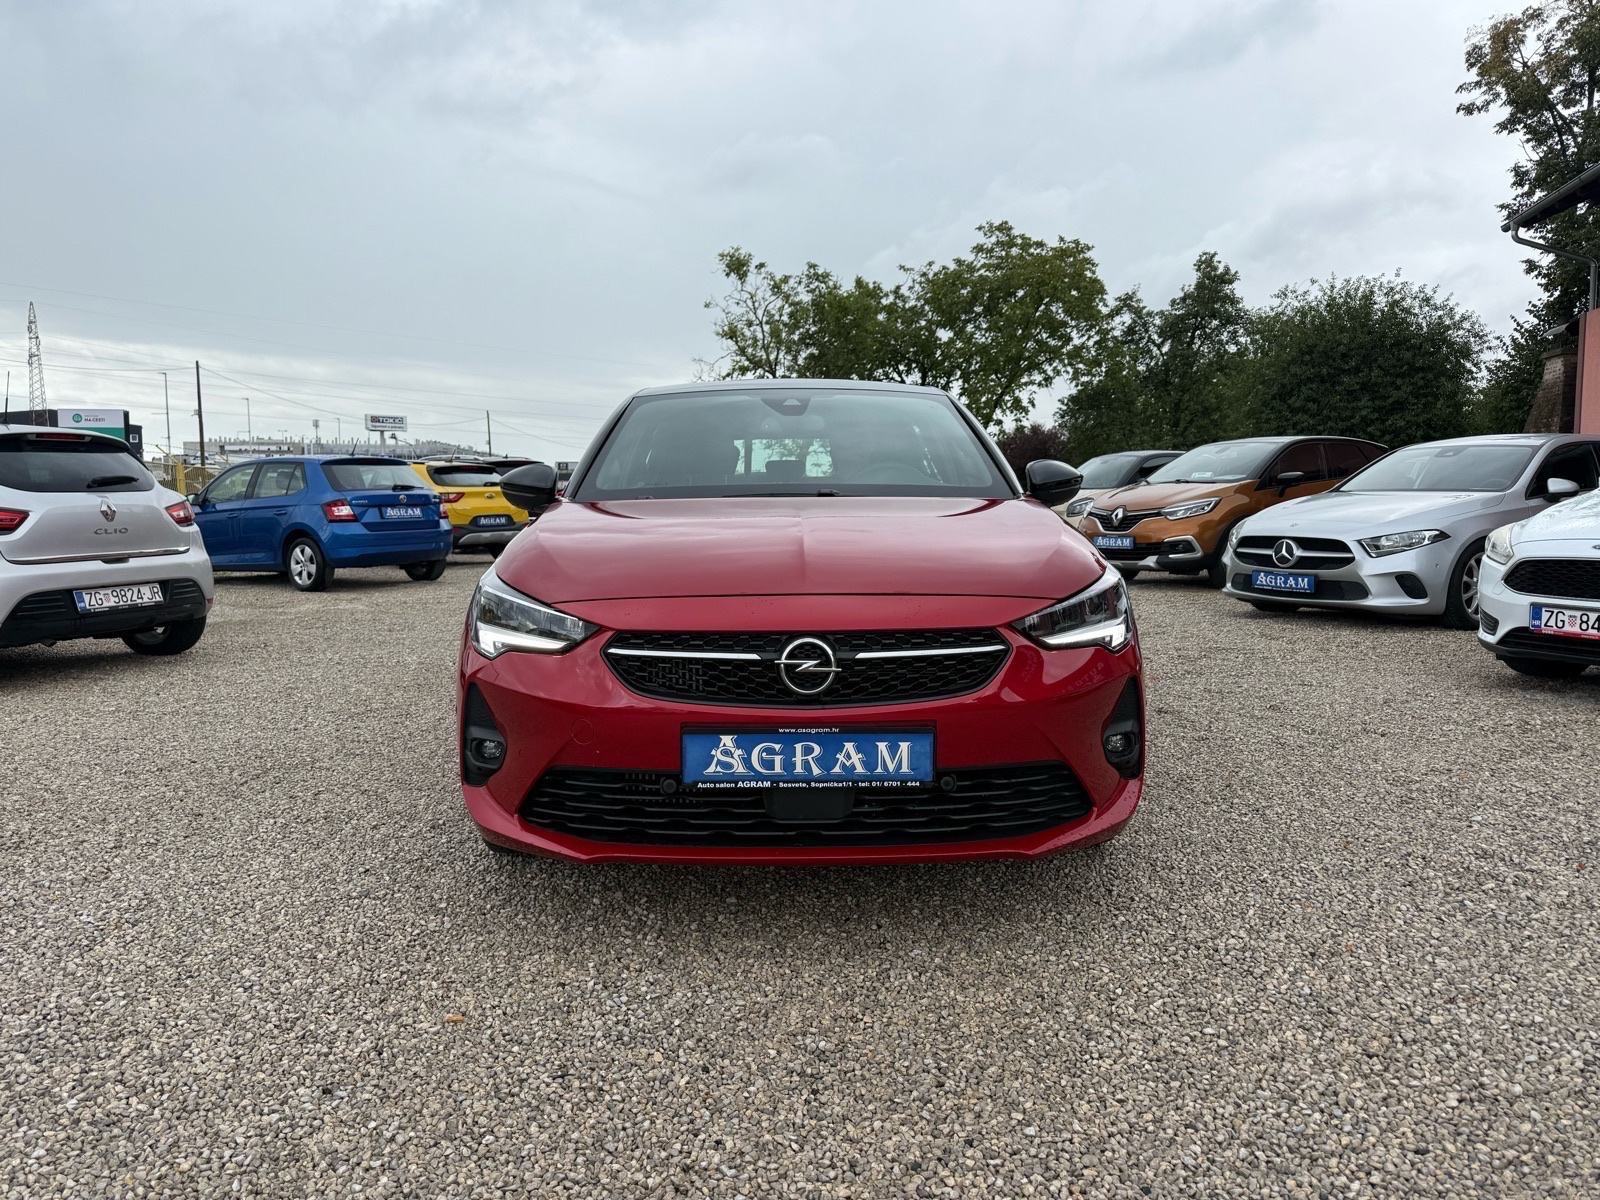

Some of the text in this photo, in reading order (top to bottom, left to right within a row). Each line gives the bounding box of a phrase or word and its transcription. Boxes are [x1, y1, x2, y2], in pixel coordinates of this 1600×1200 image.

[94, 527, 129, 535] CLIO
[1096, 536, 1131, 547] AGRAM
[1256, 572, 1309, 589] AGRAM
[85, 591, 104, 607] ZG
[1544, 609, 1566, 630] ZG
